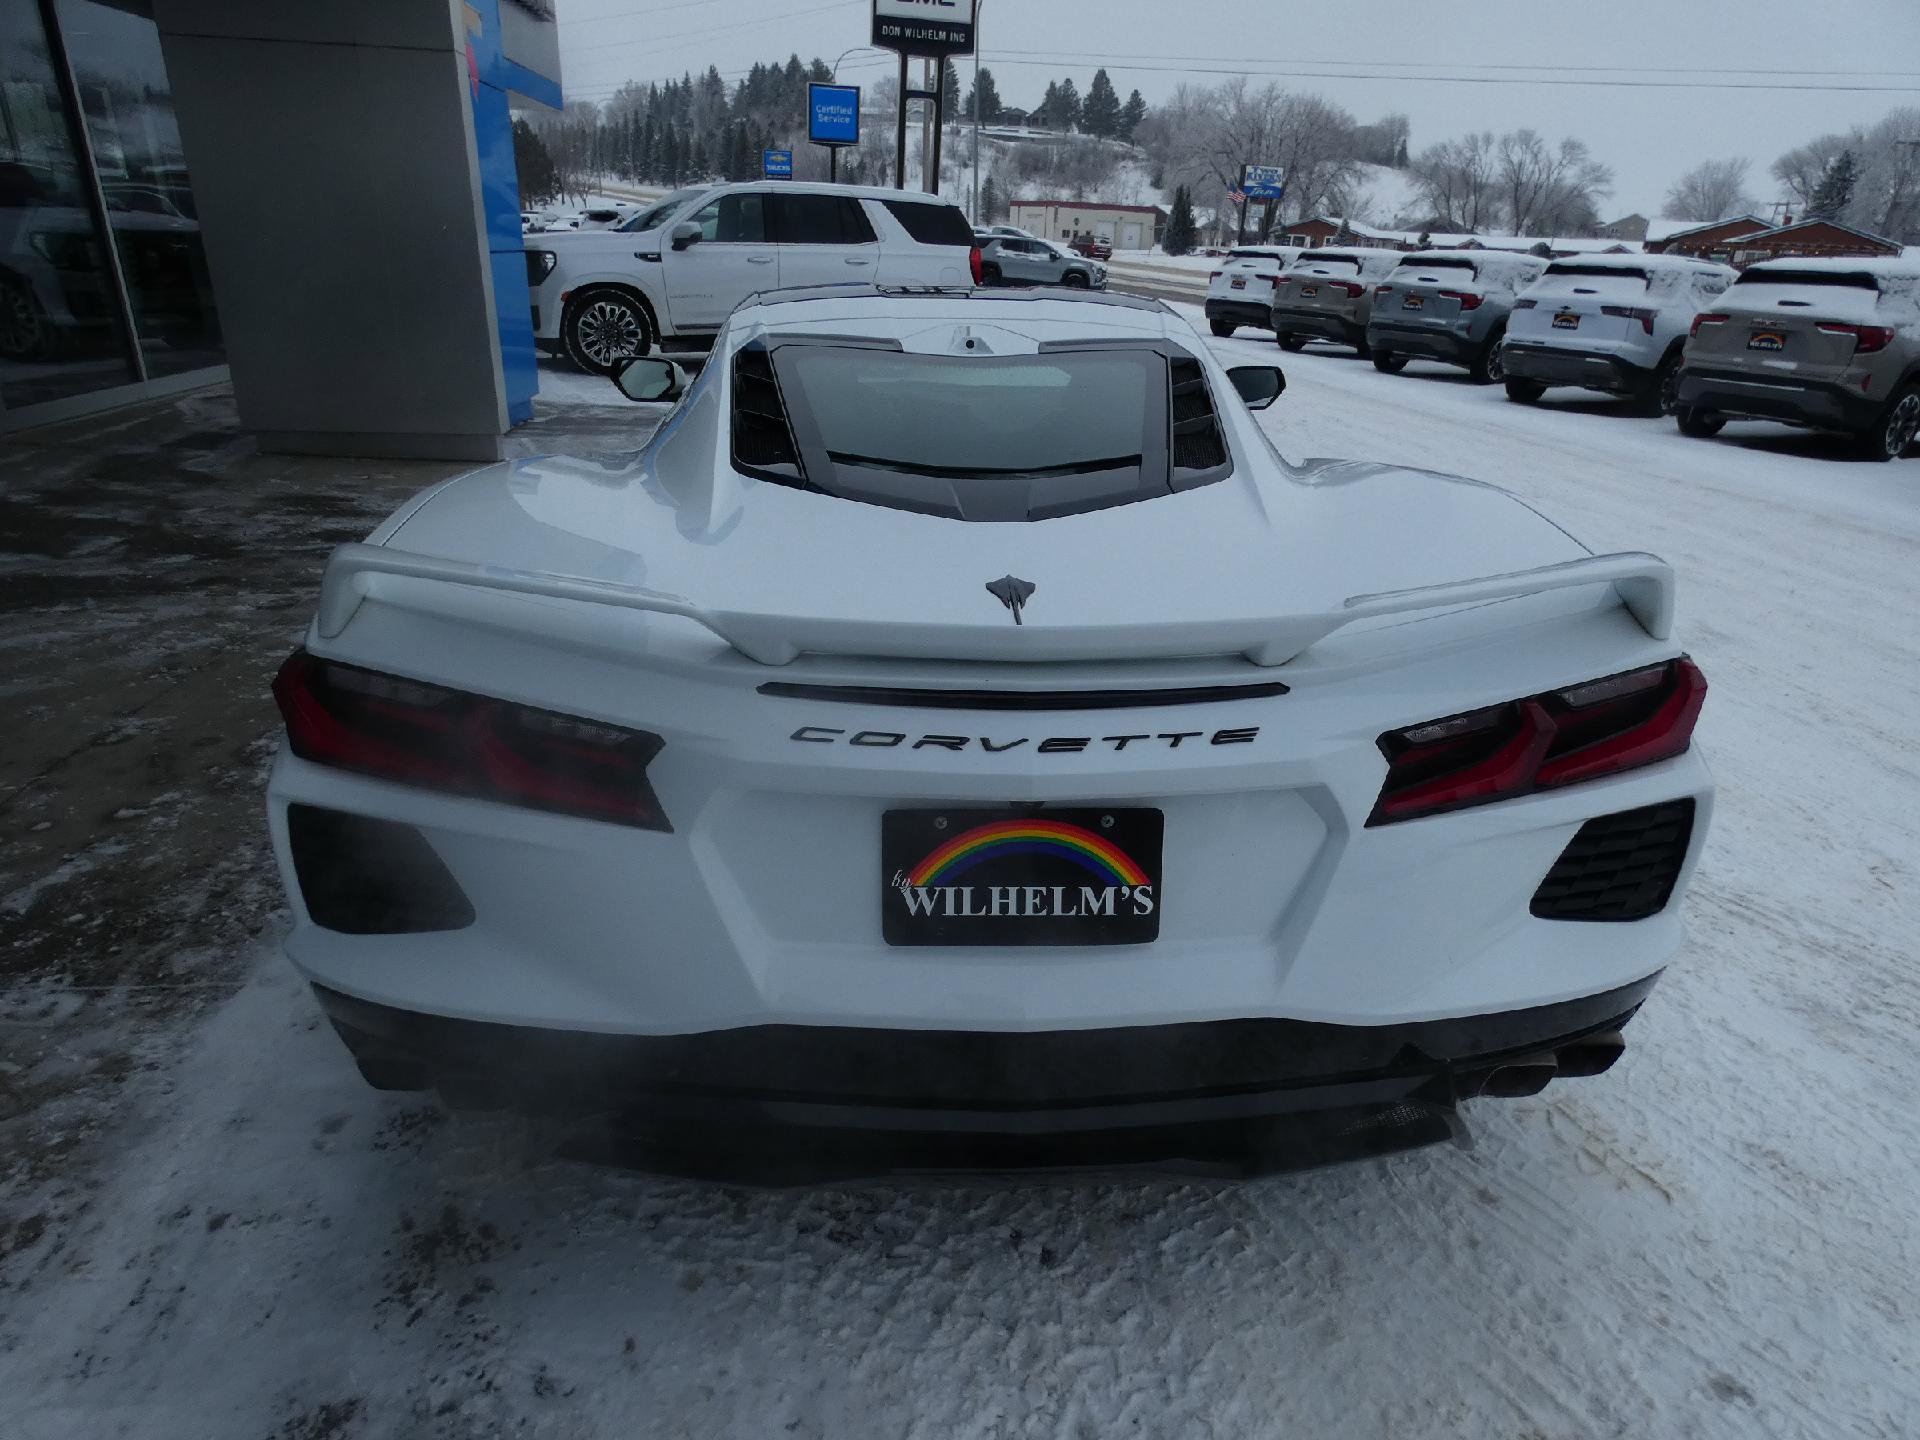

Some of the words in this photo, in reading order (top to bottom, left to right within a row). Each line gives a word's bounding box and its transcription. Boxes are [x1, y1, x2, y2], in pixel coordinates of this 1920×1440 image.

[882, 25, 900, 36] DON
[904, 27, 946, 41] WILHELM
[949, 32, 966, 43] INC
[816, 104, 852, 115] Certified
[817, 113, 850, 124] Service
[790, 726, 1260, 753] CORVETTE
[890, 869, 914, 894] by
[900, 885, 1154, 917] WILHELM'S
